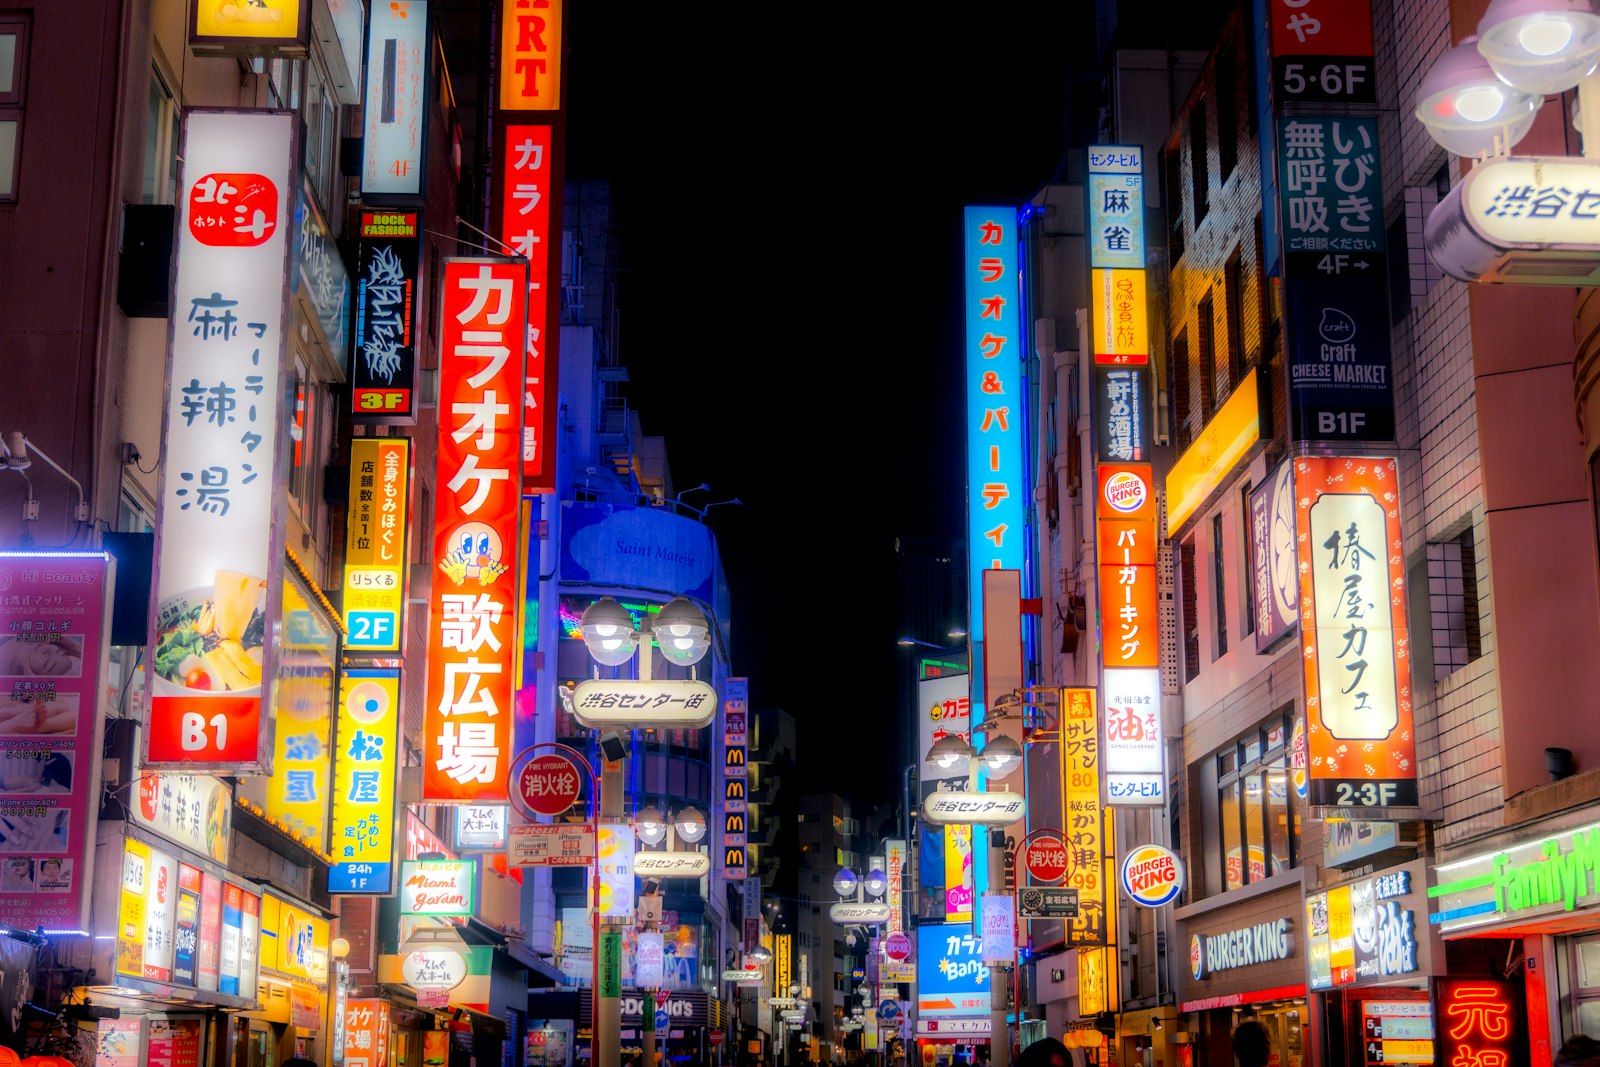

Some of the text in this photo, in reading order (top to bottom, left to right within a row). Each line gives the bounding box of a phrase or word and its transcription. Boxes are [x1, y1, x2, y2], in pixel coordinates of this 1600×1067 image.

[515, 0, 548, 96] RT
[388, 160, 415, 177] 4F
[1090, 153, 1139, 167] センタービル
[1126, 178, 1140, 187] 5F
[1284, 121, 1329, 234] 無呼吸
[1332, 122, 1375, 233] いびき
[193, 215, 227, 228] ホクト
[373, 215, 406, 226] ROCK
[1103, 188, 1131, 251] 麻雀
[364, 225, 414, 236] FASHION
[1290, 237, 1376, 250] ご相談ください
[1317, 254, 1349, 275] 4F
[1324, 321, 1350, 332] craft
[1114, 355, 1129, 364] 4F
[1320, 343, 1357, 362] Craft
[1292, 364, 1386, 384] CHEESE MARKET
[360, 391, 403, 409] 3F
[446, 266, 514, 516] カラオケ
[176, 292, 239, 517] 麻辣湯
[240, 322, 267, 485] マーラータン
[1107, 371, 1134, 461] 一軒め酒場
[1318, 411, 1366, 434] B1F
[1110, 480, 1140, 494] BURGER
[1111, 485, 1142, 505] KING
[357, 461, 375, 550] 店舗数全国1位
[381, 450, 400, 560] 全身もみほぐし
[615, 540, 651, 558] Saint
[23, 571, 98, 585] Hi Beauty
[353, 574, 394, 586] りらくる
[1117, 528, 1140, 660] バーガーキング
[9, 620, 72, 632] 小顔コルギ
[1322, 521, 1377, 712] 椿屋カフェ
[16, 632, 61, 643] 5500円
[354, 617, 390, 640] 2F
[436, 592, 504, 785] 歌広場
[580, 693, 708, 710] 渋谷センター街
[181, 712, 228, 751] B1
[1107, 707, 1144, 743] 油
[1144, 712, 1158, 742] そば
[1067, 723, 1082, 770] サワー
[1083, 719, 1097, 768] レモン
[349, 730, 384, 803] 松屋
[528, 762, 569, 771] FIRE HYDRANT
[525, 772, 575, 798] 消火栓
[1071, 773, 1093, 787] 80
[1109, 780, 1161, 797] センタービル
[469, 808, 494, 819] てんぐ
[932, 800, 1022, 813] 渋谷センター街
[1069, 800, 1097, 812] 秘伝
[369, 813, 380, 847] 牛めし
[463, 818, 500, 830] 大ホール
[344, 826, 355, 857] 定食
[356, 818, 367, 851] カレー
[634, 858, 705, 869] 渋谷センター街
[1029, 850, 1066, 868] 消火栓
[1128, 856, 1174, 877] BURGER
[348, 865, 372, 875] 24h
[351, 878, 368, 888] 1F
[405, 874, 457, 889] Miami
[1073, 873, 1097, 890] 99
[1131, 866, 1176, 895] KING
[1206, 927, 1253, 973] BURGER
[1253, 918, 1288, 963] KING
[1377, 901, 1402, 976] 油
[416, 968, 452, 981] 大ホール
